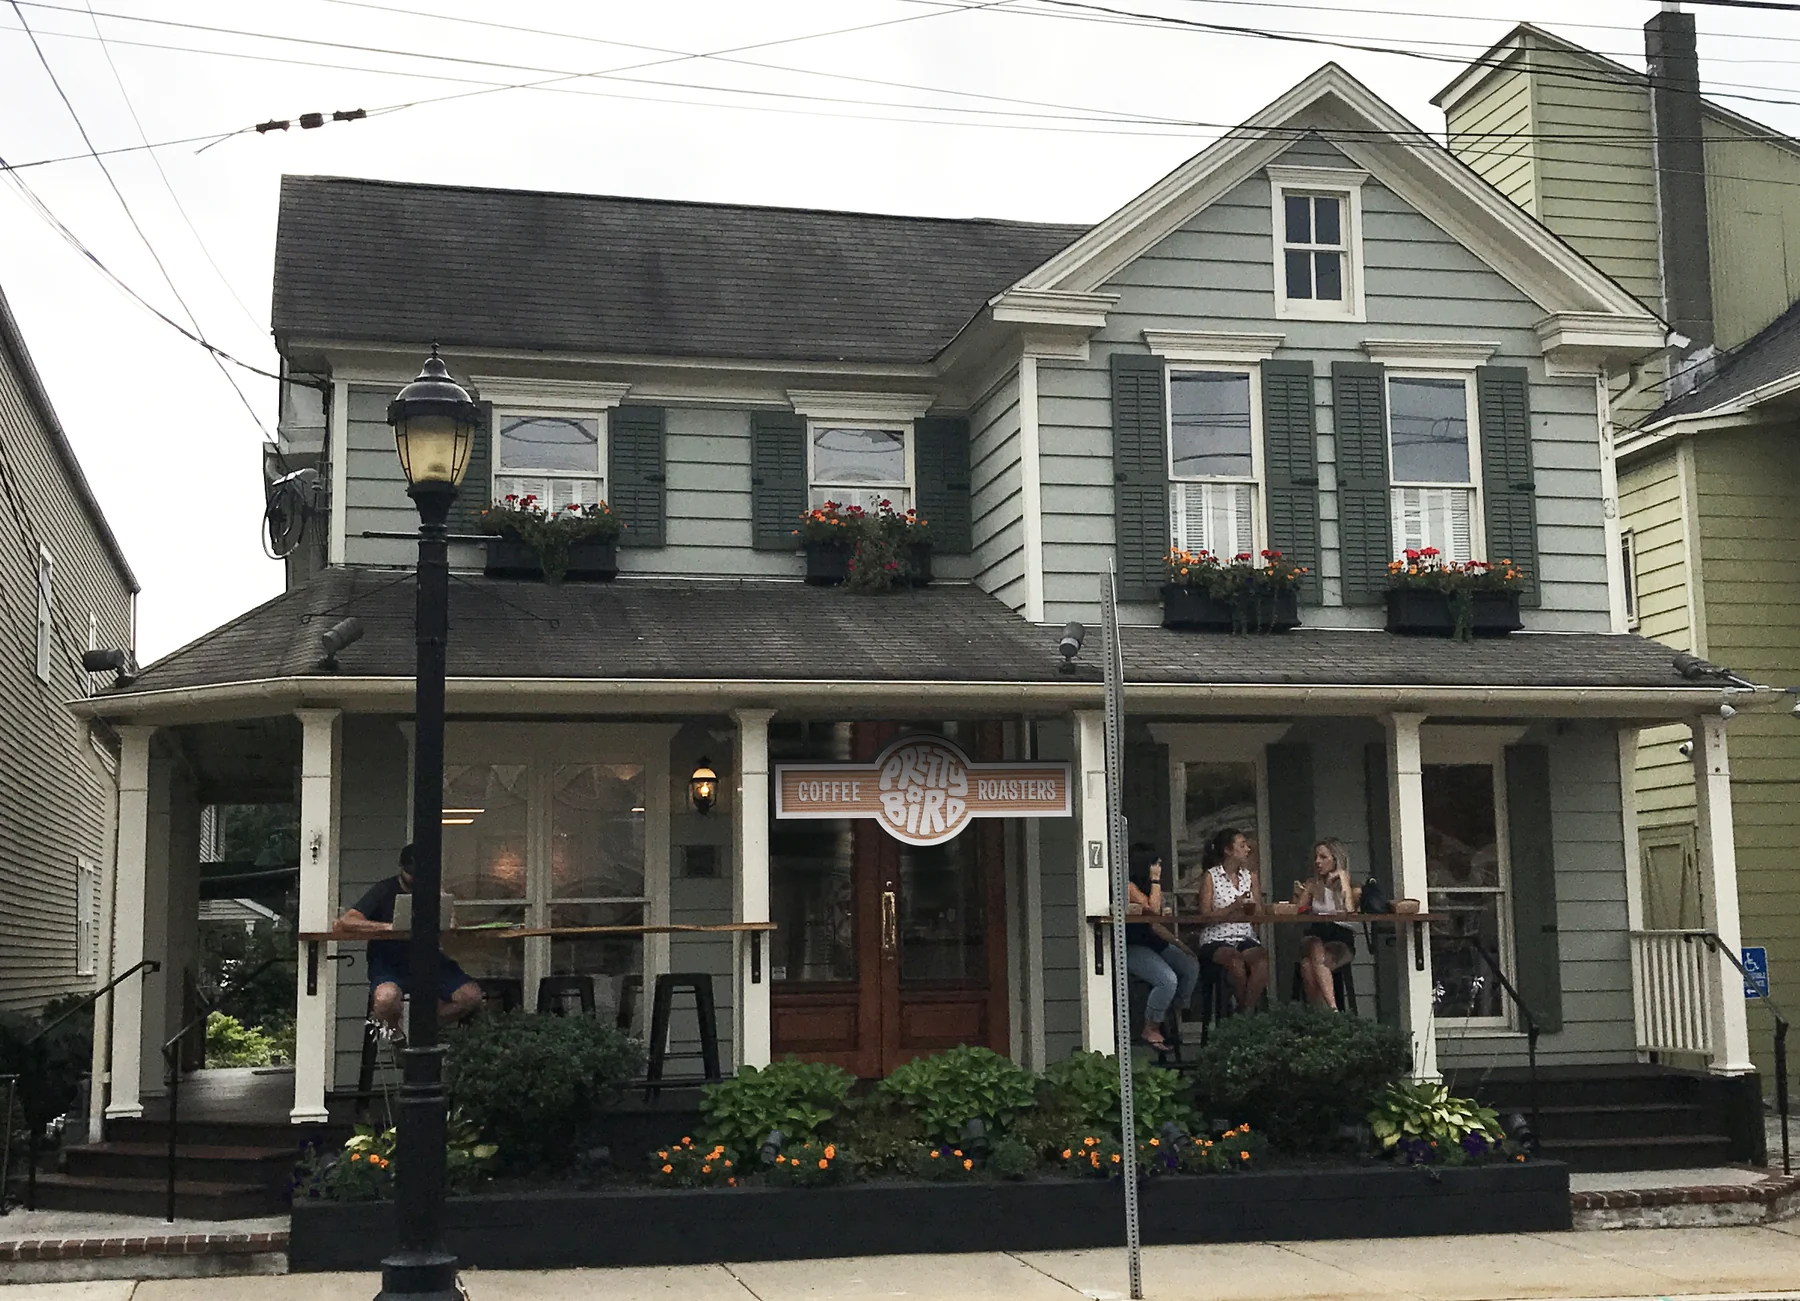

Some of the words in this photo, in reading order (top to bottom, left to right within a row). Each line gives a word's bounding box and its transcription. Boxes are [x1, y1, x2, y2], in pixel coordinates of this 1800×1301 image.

[879, 746, 968, 797] PRETTY
[798, 781, 861, 802] COFFEE
[978, 779, 1057, 801] ROASTERS
[880, 787, 966, 835] BIRD
[1091, 843, 1101, 865] 7
